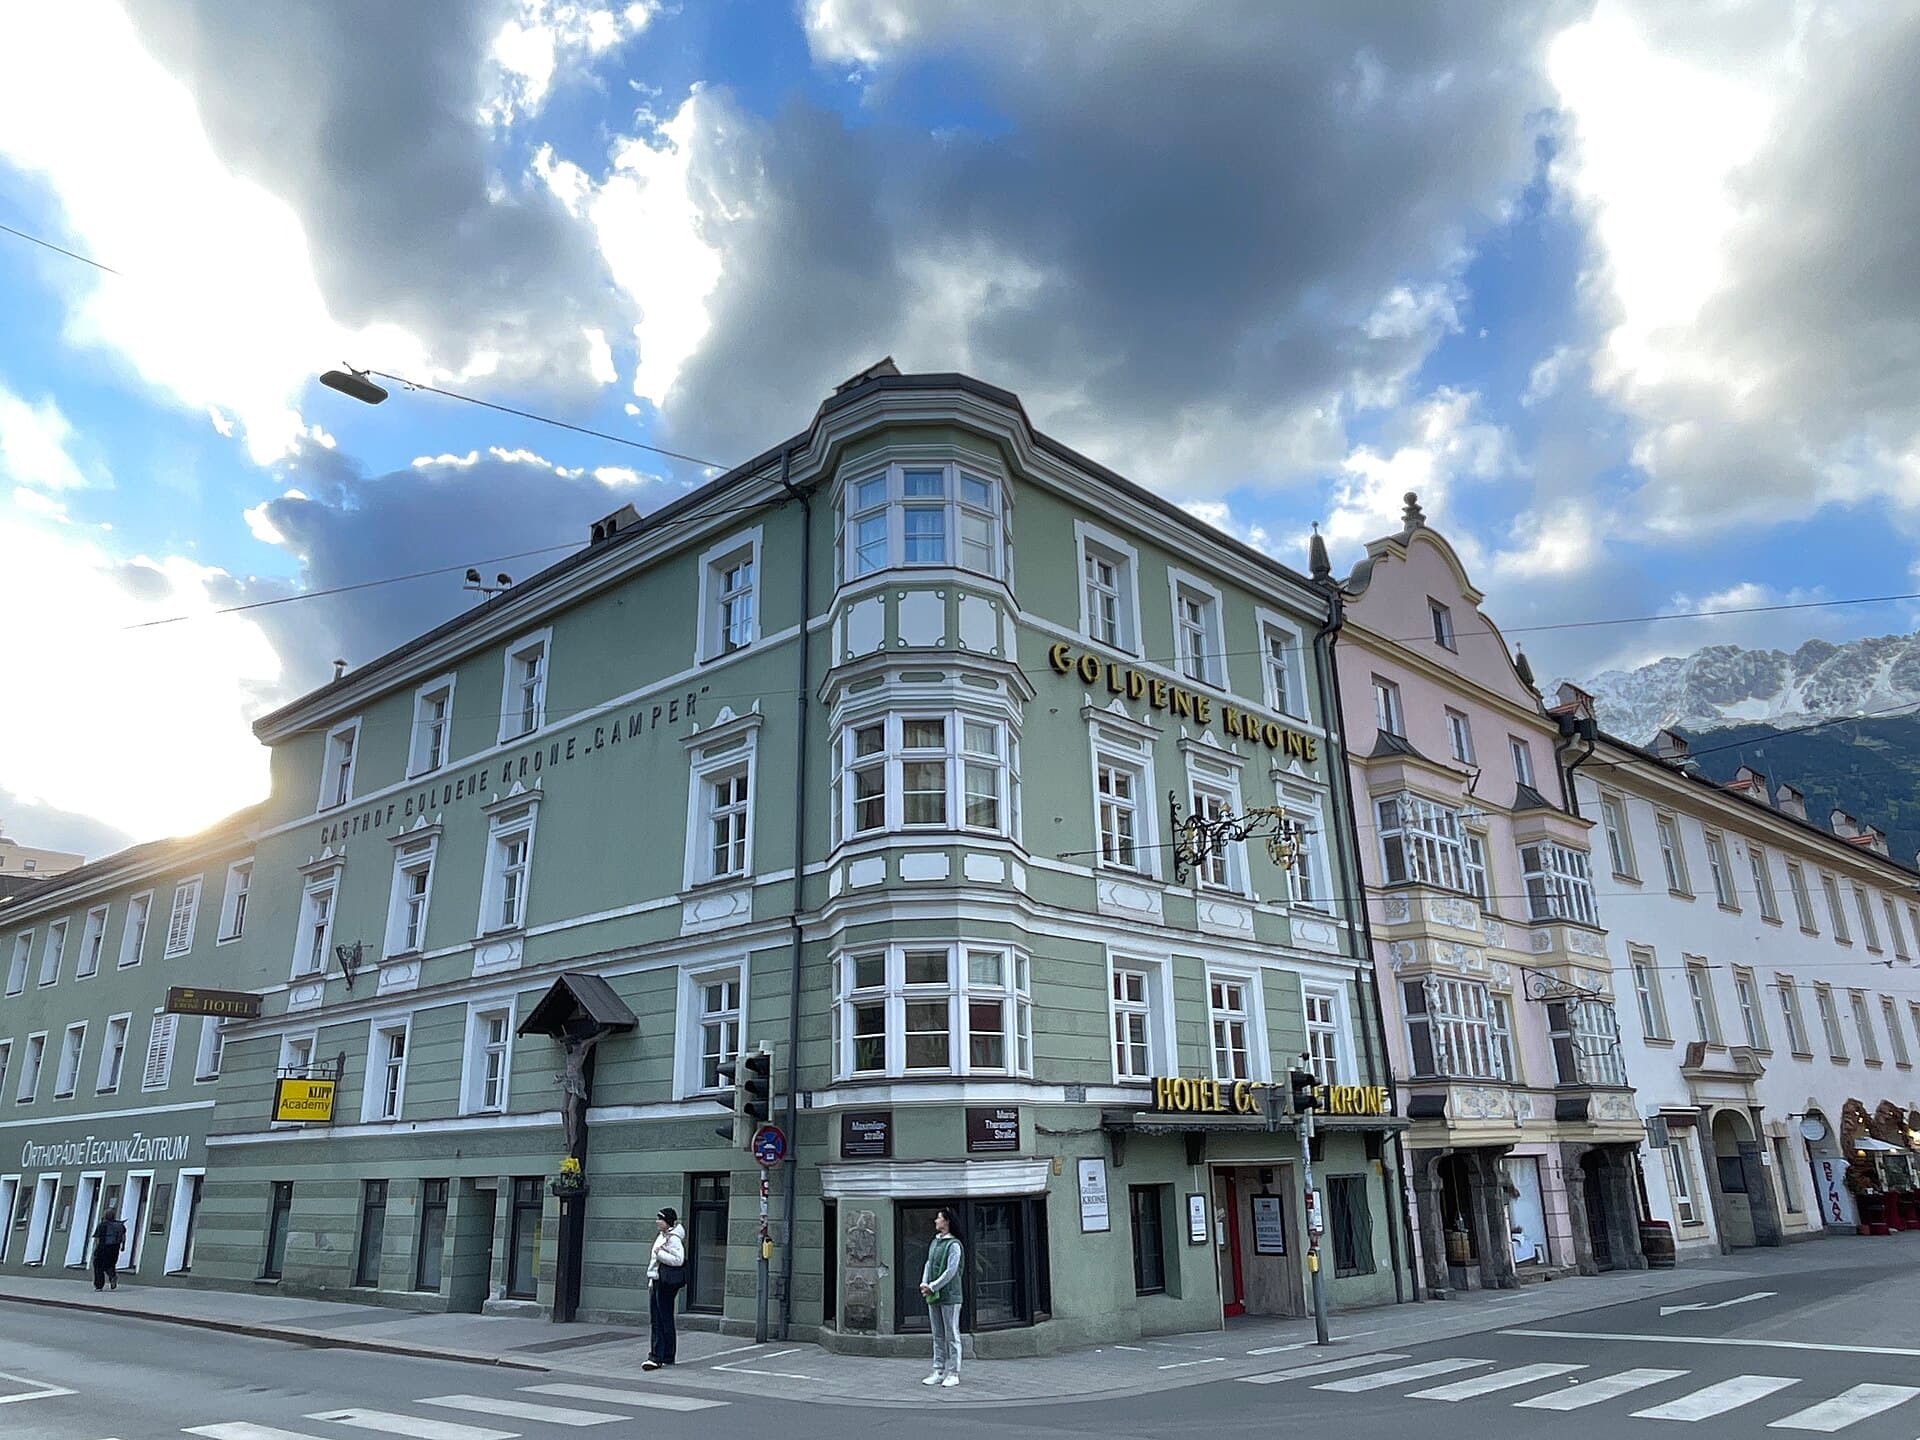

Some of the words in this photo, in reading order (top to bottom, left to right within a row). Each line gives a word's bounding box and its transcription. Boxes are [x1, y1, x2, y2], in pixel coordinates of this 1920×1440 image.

[1050, 642, 1211, 725] GOLDENE
[1222, 706, 1318, 762] KRONE
[320, 804, 395, 844] GASTHOF
[405, 769, 489, 817] GOLDENE
[502, 737, 576, 783] KRONE
[280, 1099, 330, 1112] Academy
[1156, 1076, 1227, 1112] HOTEL
[1330, 1085, 1389, 1115] KRONE
[1822, 1161, 1843, 1222] RE/MAX
